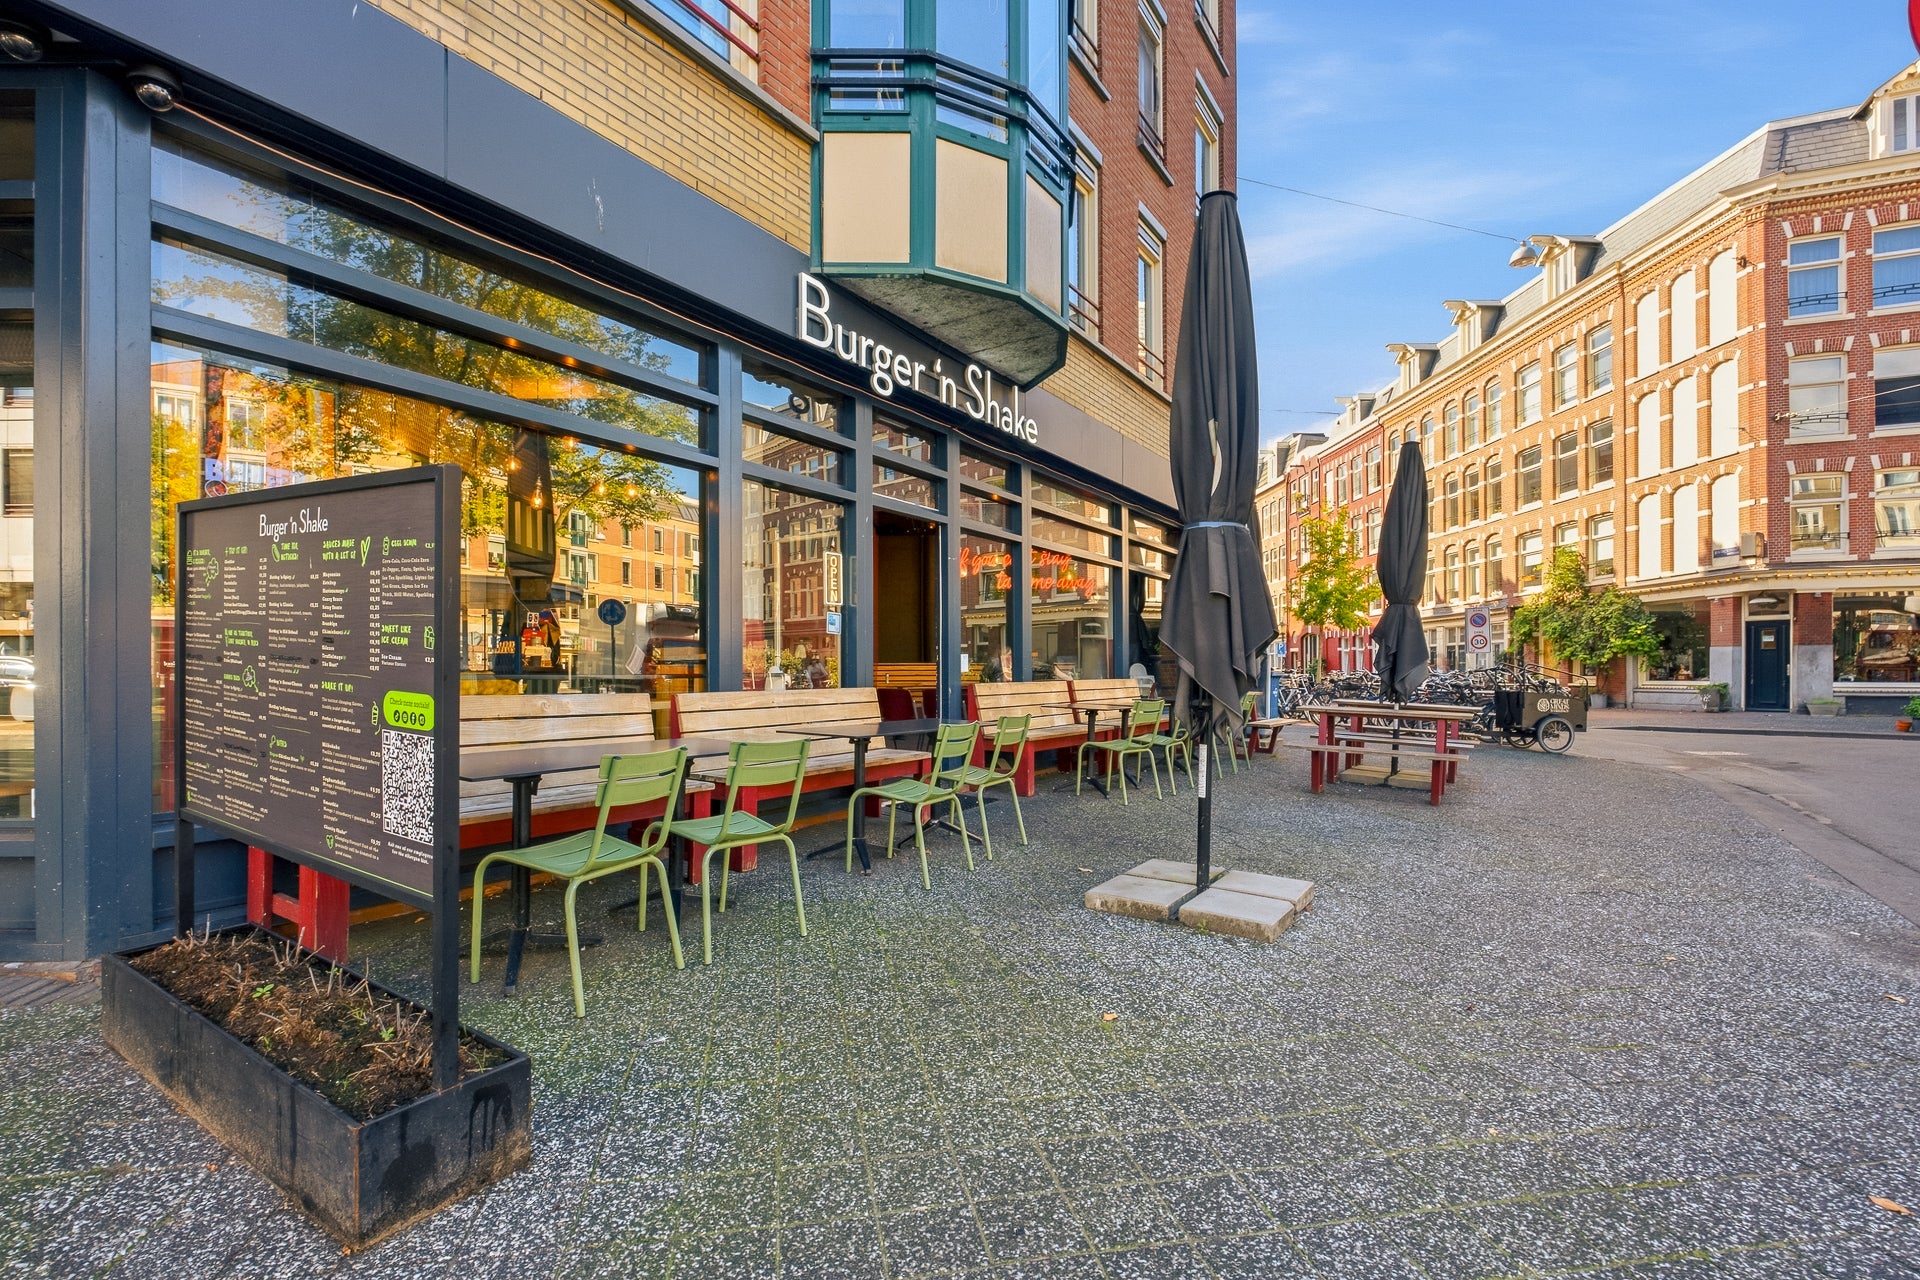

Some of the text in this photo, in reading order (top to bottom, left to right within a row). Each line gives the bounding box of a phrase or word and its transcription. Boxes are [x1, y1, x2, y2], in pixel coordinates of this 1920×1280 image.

[797, 271, 925, 396] Burger
[964, 363, 1038, 444] Shake
[259, 514, 288, 542] Burger
[299, 506, 329, 534] Shake
[323, 540, 341, 549] SAUCES
[1039, 551, 1072, 572] stay
[829, 556, 838, 602] OPEN
[1056, 576, 1098, 598] away
[381, 624, 411, 633] SWEET LIKE
[381, 636, 409, 646] ICE CREAM
[1474, 638, 1485, 646] 30
[389, 697, 403, 705] Check
